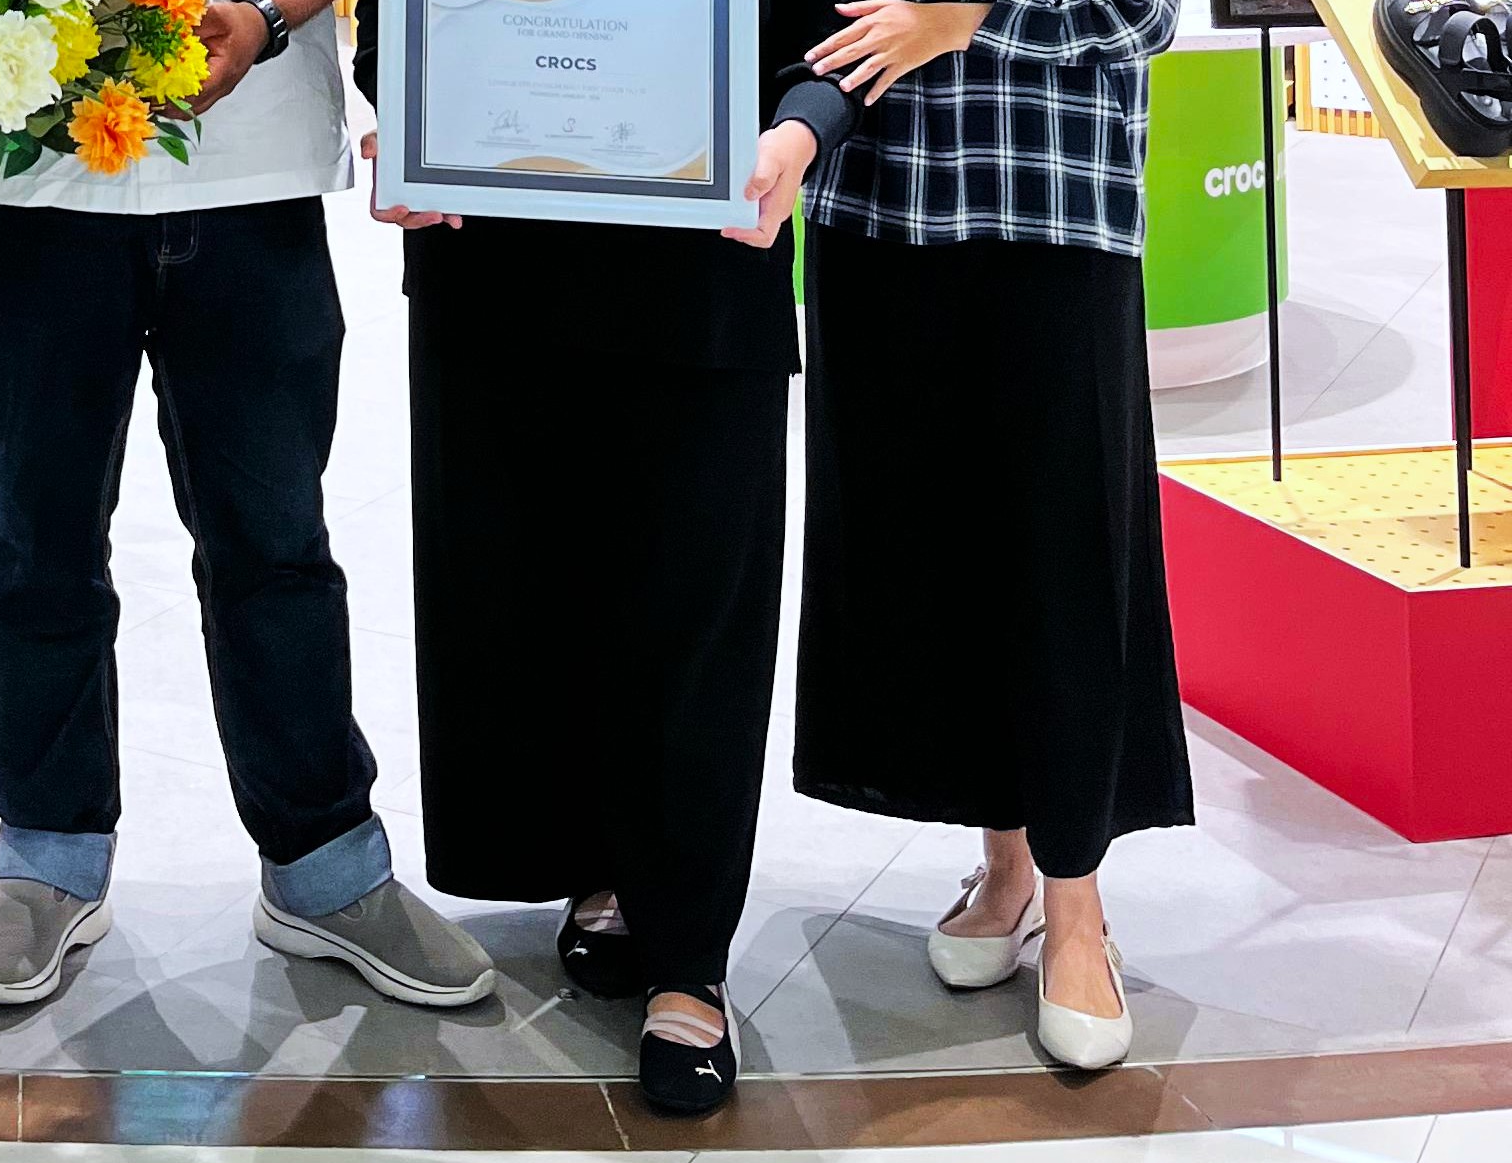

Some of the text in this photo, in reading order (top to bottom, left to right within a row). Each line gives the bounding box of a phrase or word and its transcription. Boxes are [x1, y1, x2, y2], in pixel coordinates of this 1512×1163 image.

[502, 14, 628, 32] CONGRATULATION
[518, 29, 535, 37] FOR
[536, 56, 597, 71] CROCS
[1204, 159, 1266, 198] croc
